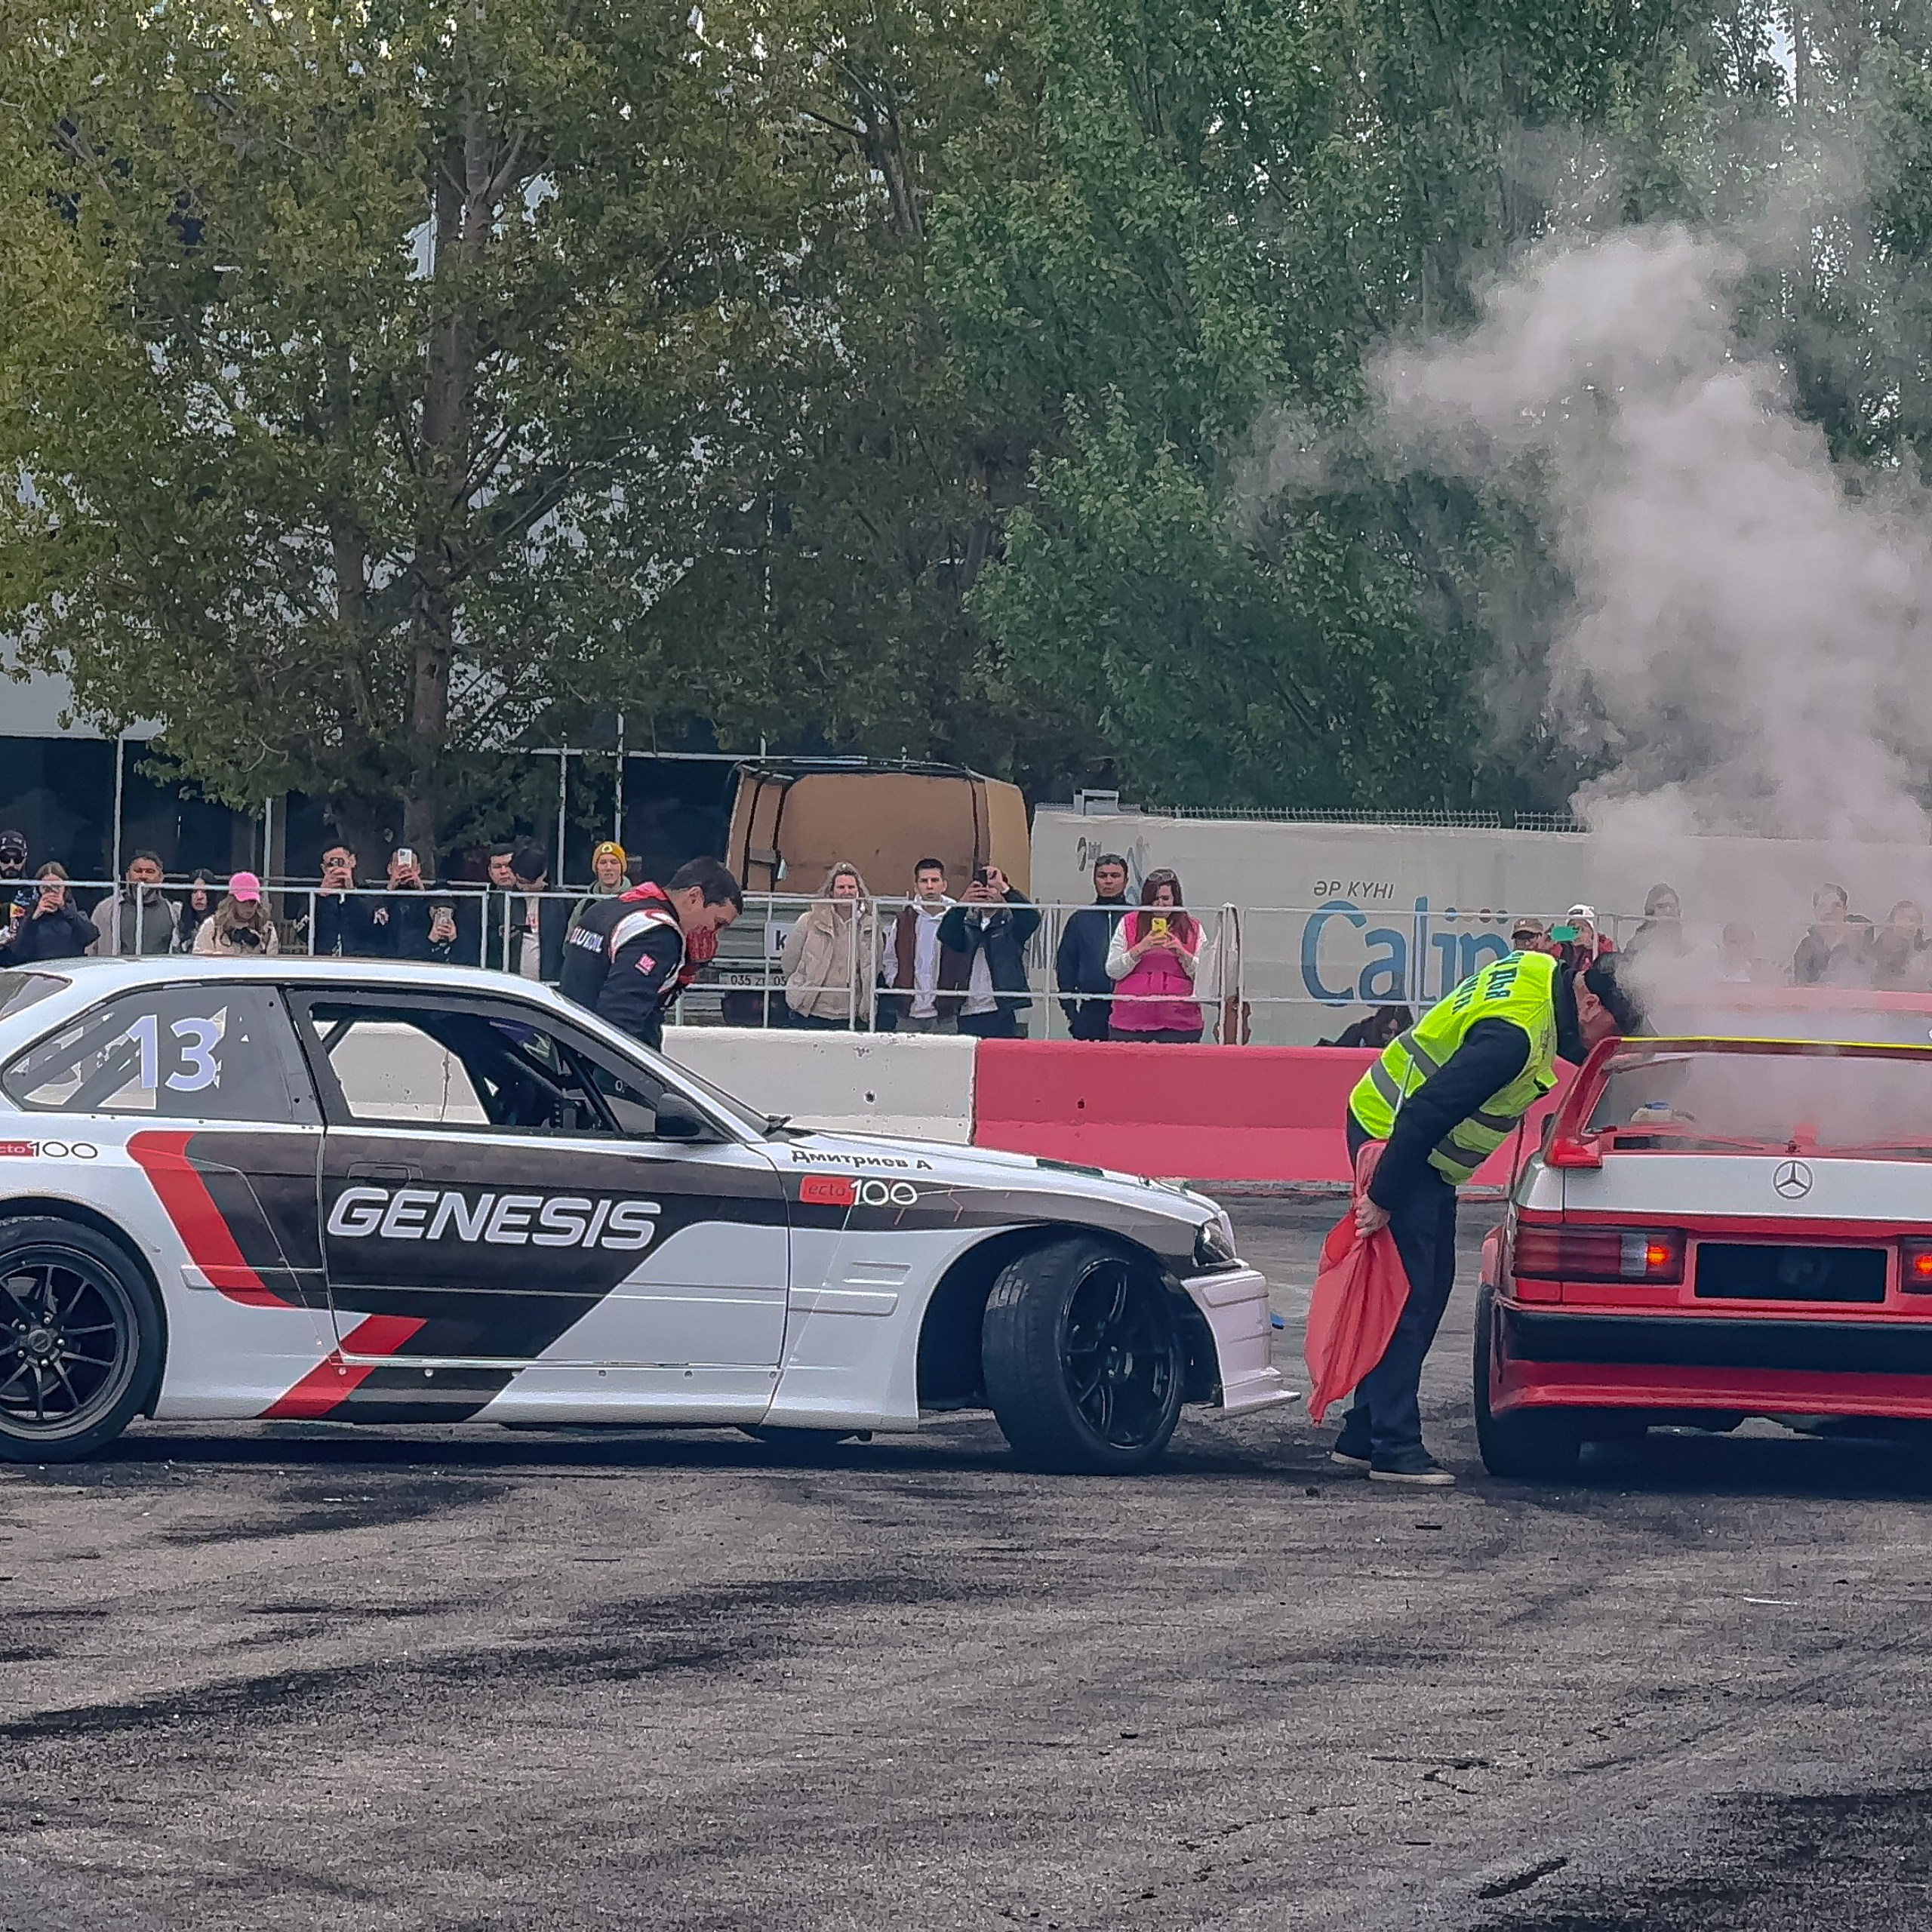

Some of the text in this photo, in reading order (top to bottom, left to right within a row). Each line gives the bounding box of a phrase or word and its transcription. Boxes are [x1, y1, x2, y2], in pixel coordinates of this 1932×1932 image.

[730, 974, 752, 986] 035
[125, 1014, 218, 1091] 13
[0, 1144, 26, 1154] cto
[327, 1186, 662, 1251] GENESIS
